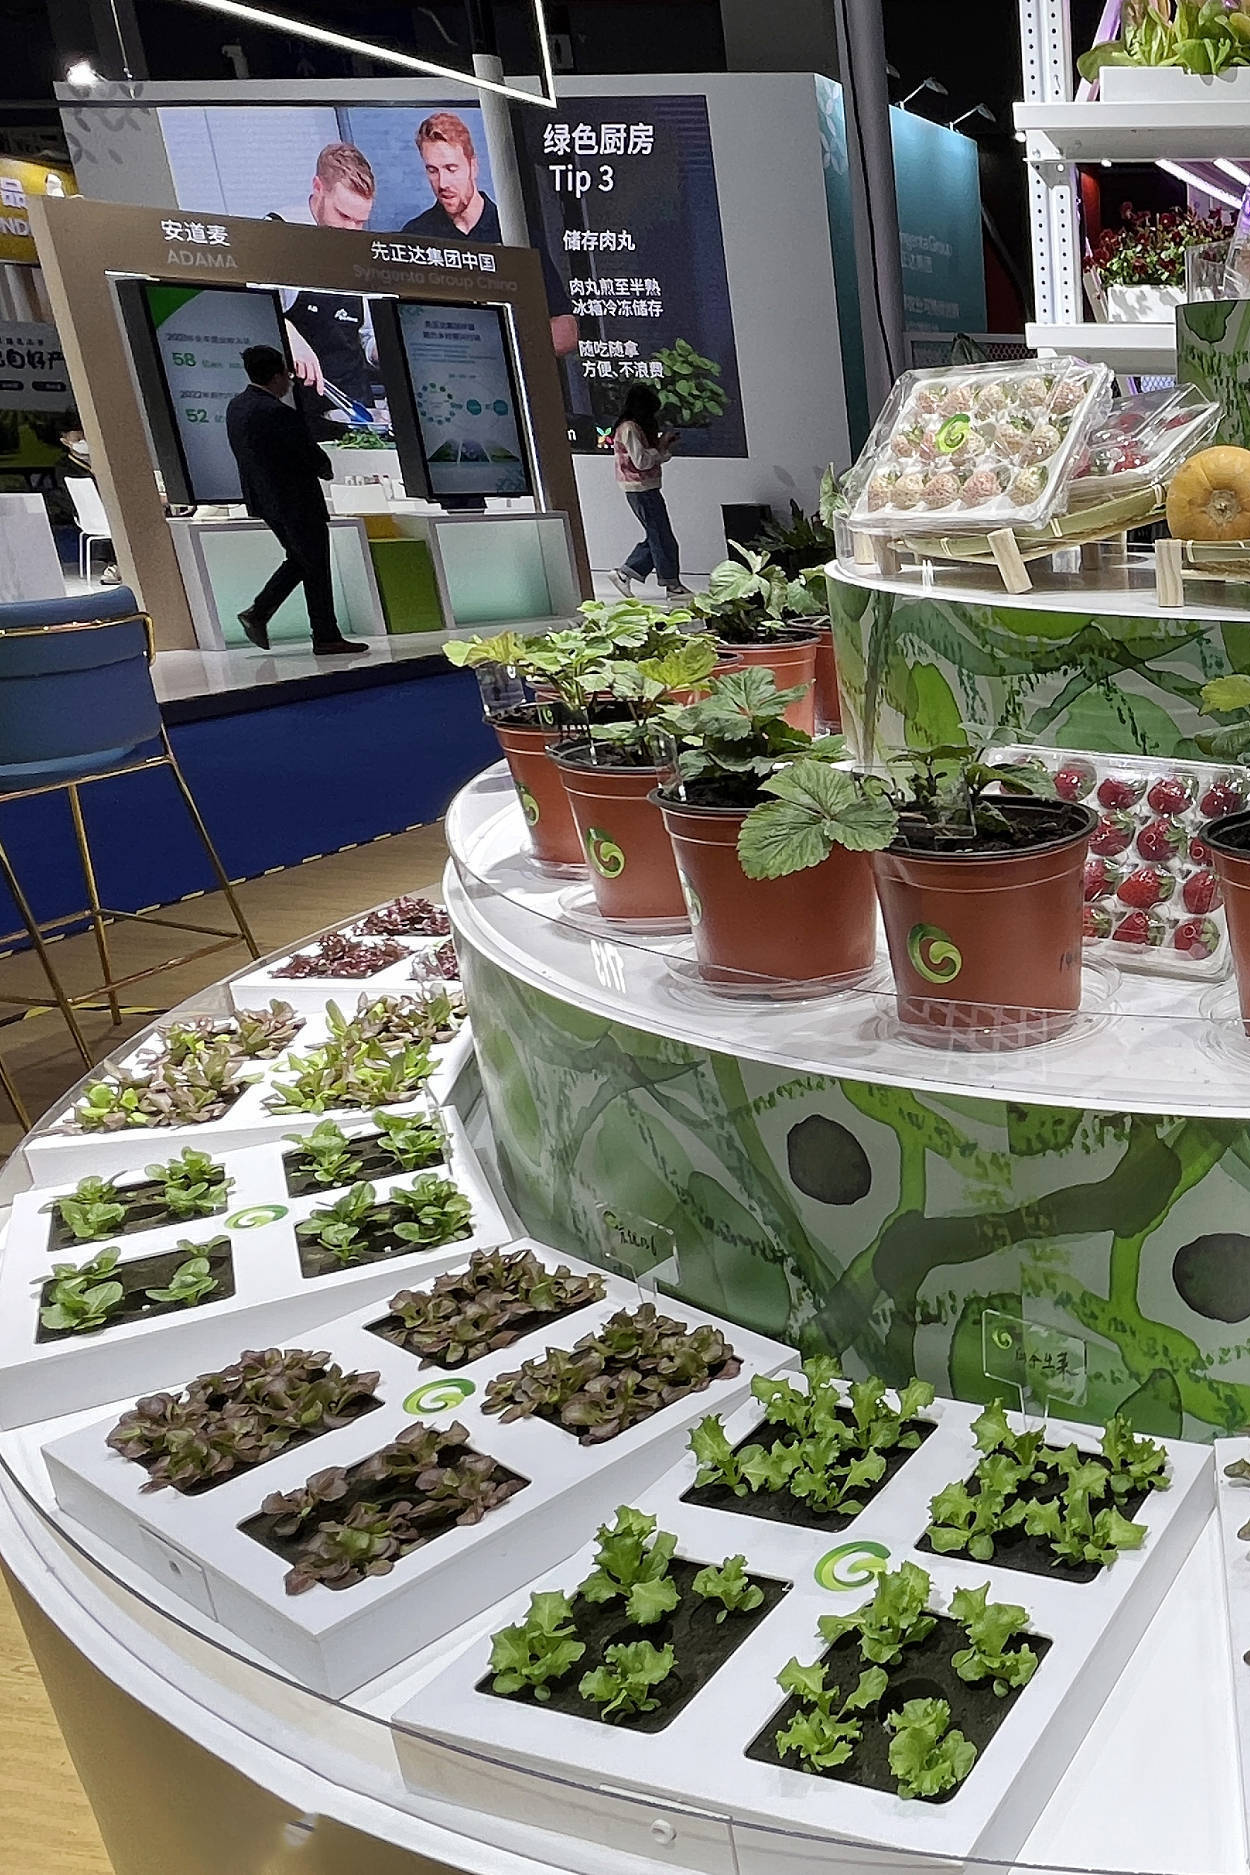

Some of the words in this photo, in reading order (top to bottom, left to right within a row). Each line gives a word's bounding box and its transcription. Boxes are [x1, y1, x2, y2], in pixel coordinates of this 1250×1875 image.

[543, 122, 655, 156] 绿色厨房
[549, 164, 591, 198] Tip
[598, 165, 615, 192] 3
[160, 219, 231, 248] 安道麦
[562, 230, 636, 252] 储存肉丸
[167, 250, 238, 270] ADAMA
[371, 241, 496, 273] 先正达集团中国
[353, 264, 425, 285] Syngenta
[428, 271, 474, 291] Group
[476, 276, 518, 292] China
[568, 277, 662, 297] 肉丸煎至半熟
[571, 298, 664, 318] 冰箱冷冻储存
[578, 340, 640, 358] 随吃随拿
[582, 360, 665, 378] 方便、不浪费
[186, 409, 209, 423] 52
